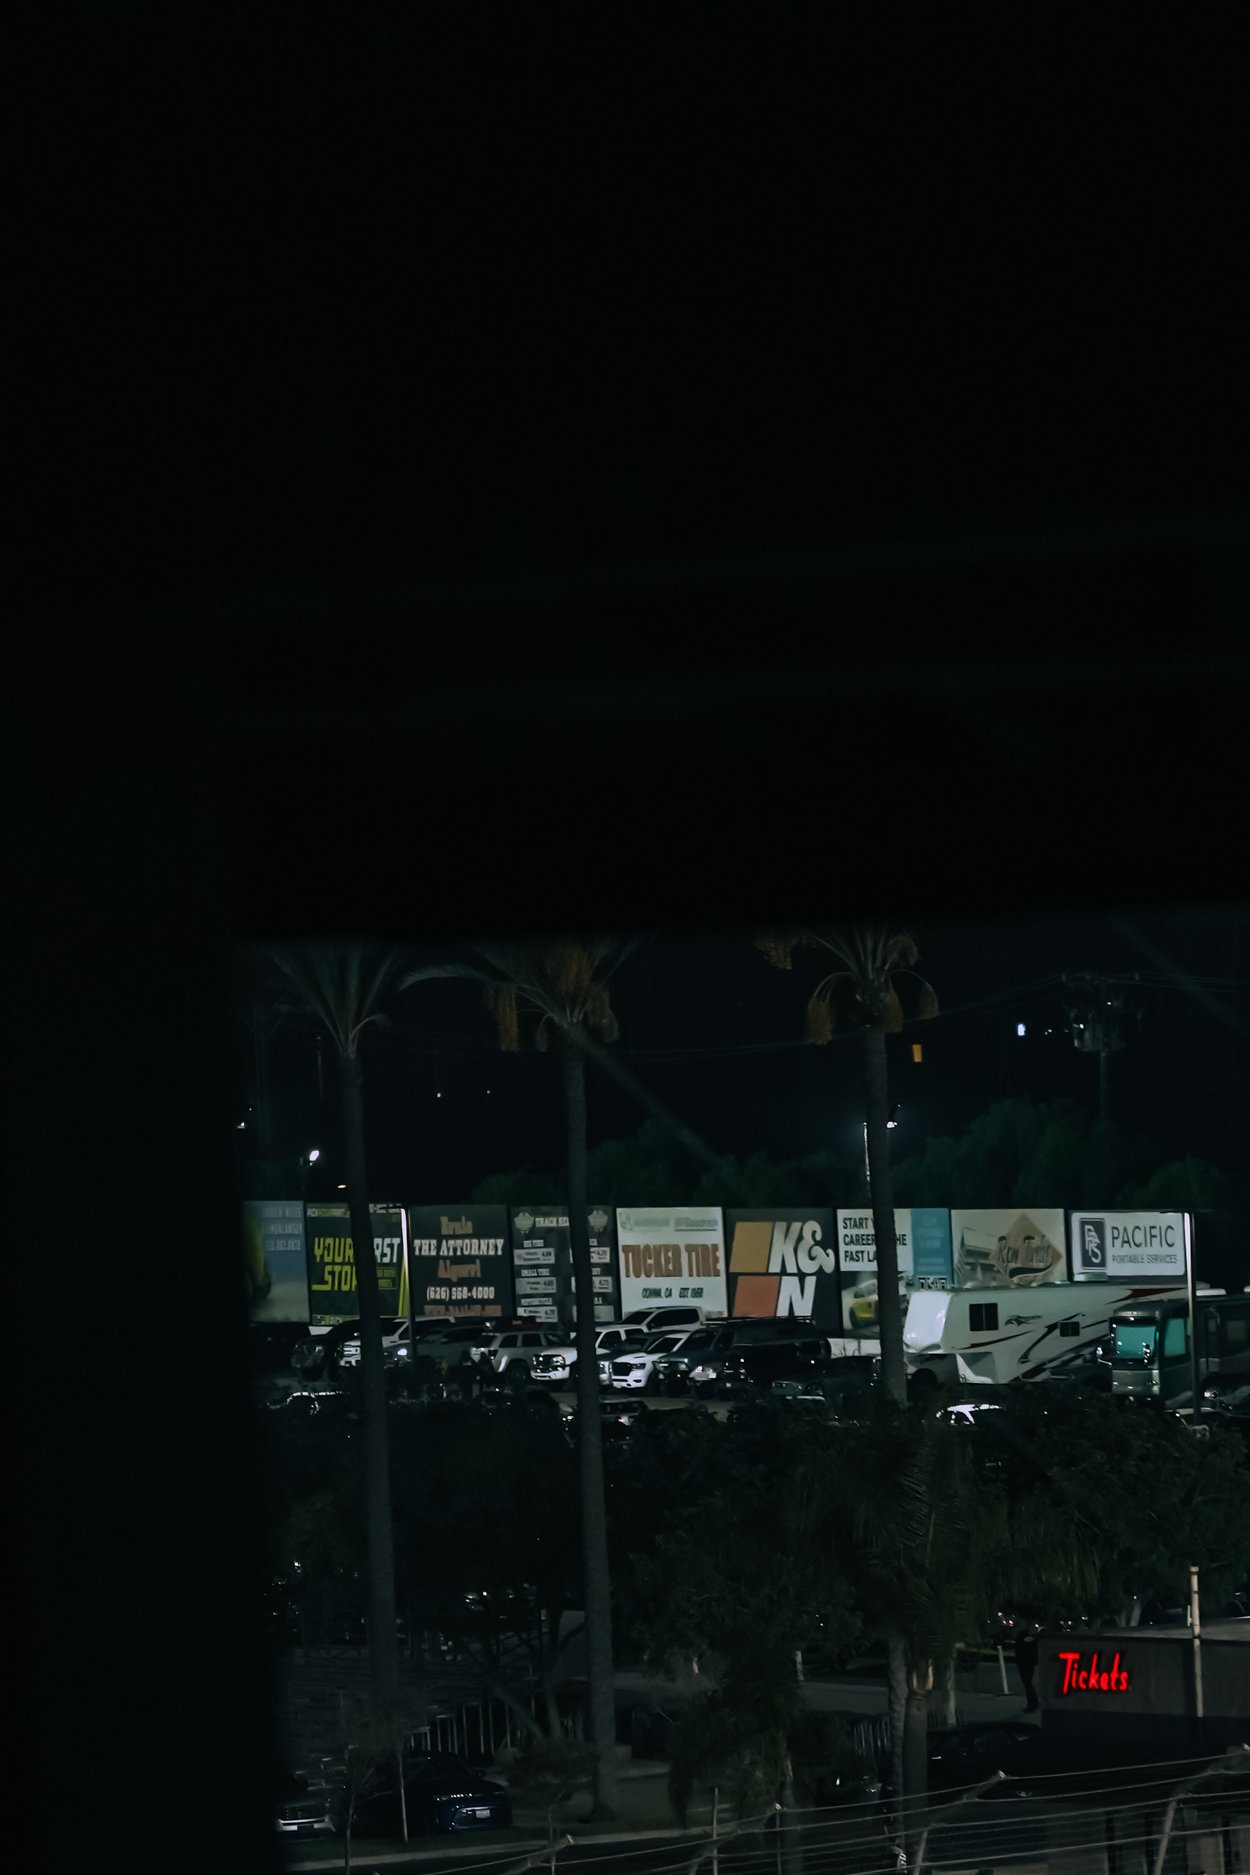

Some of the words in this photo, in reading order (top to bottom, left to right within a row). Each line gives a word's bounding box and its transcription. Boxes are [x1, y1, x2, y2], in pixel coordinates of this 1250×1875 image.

[843, 1217, 869, 1230] START
[413, 1238, 437, 1256] THE
[440, 1238, 504, 1256] ATTORNEY
[1111, 1225, 1176, 1249] PACIFIC
[314, 1237, 355, 1263] YOUR
[373, 1237, 401, 1264] RST
[621, 1244, 682, 1278] TUCKER
[685, 1243, 720, 1277] TIRE
[845, 1250, 865, 1263] FAST
[1112, 1254, 1145, 1264] PORTABLE
[1146, 1254, 1178, 1264] SERVICES
[1058, 1651, 1130, 1696] Tickets
